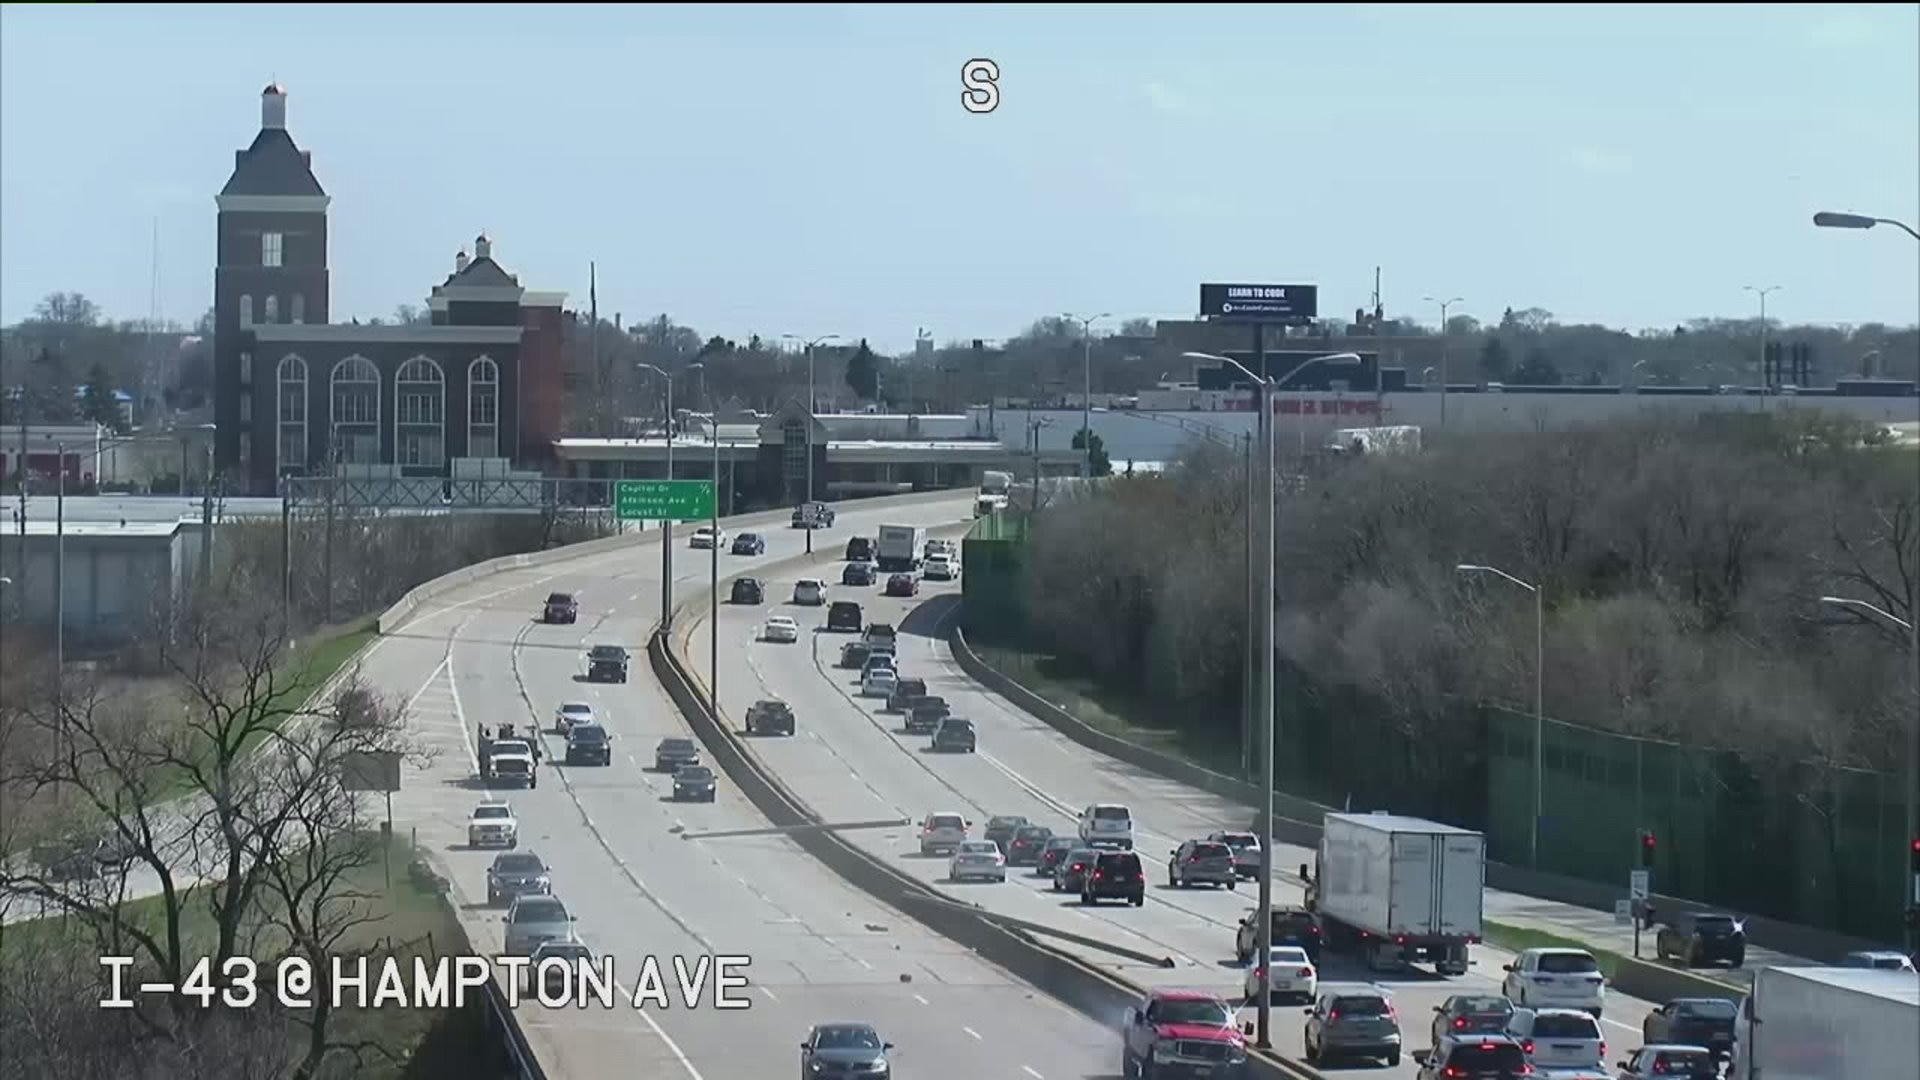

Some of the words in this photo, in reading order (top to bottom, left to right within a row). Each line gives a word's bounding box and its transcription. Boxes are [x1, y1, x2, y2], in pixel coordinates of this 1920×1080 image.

[1228, 288, 1252, 297] LEARN
[1253, 288, 1263, 297] TO
[1264, 288, 1285, 298] CODE
[621, 484, 655, 493] Capitol
[620, 508, 652, 516] Locust
